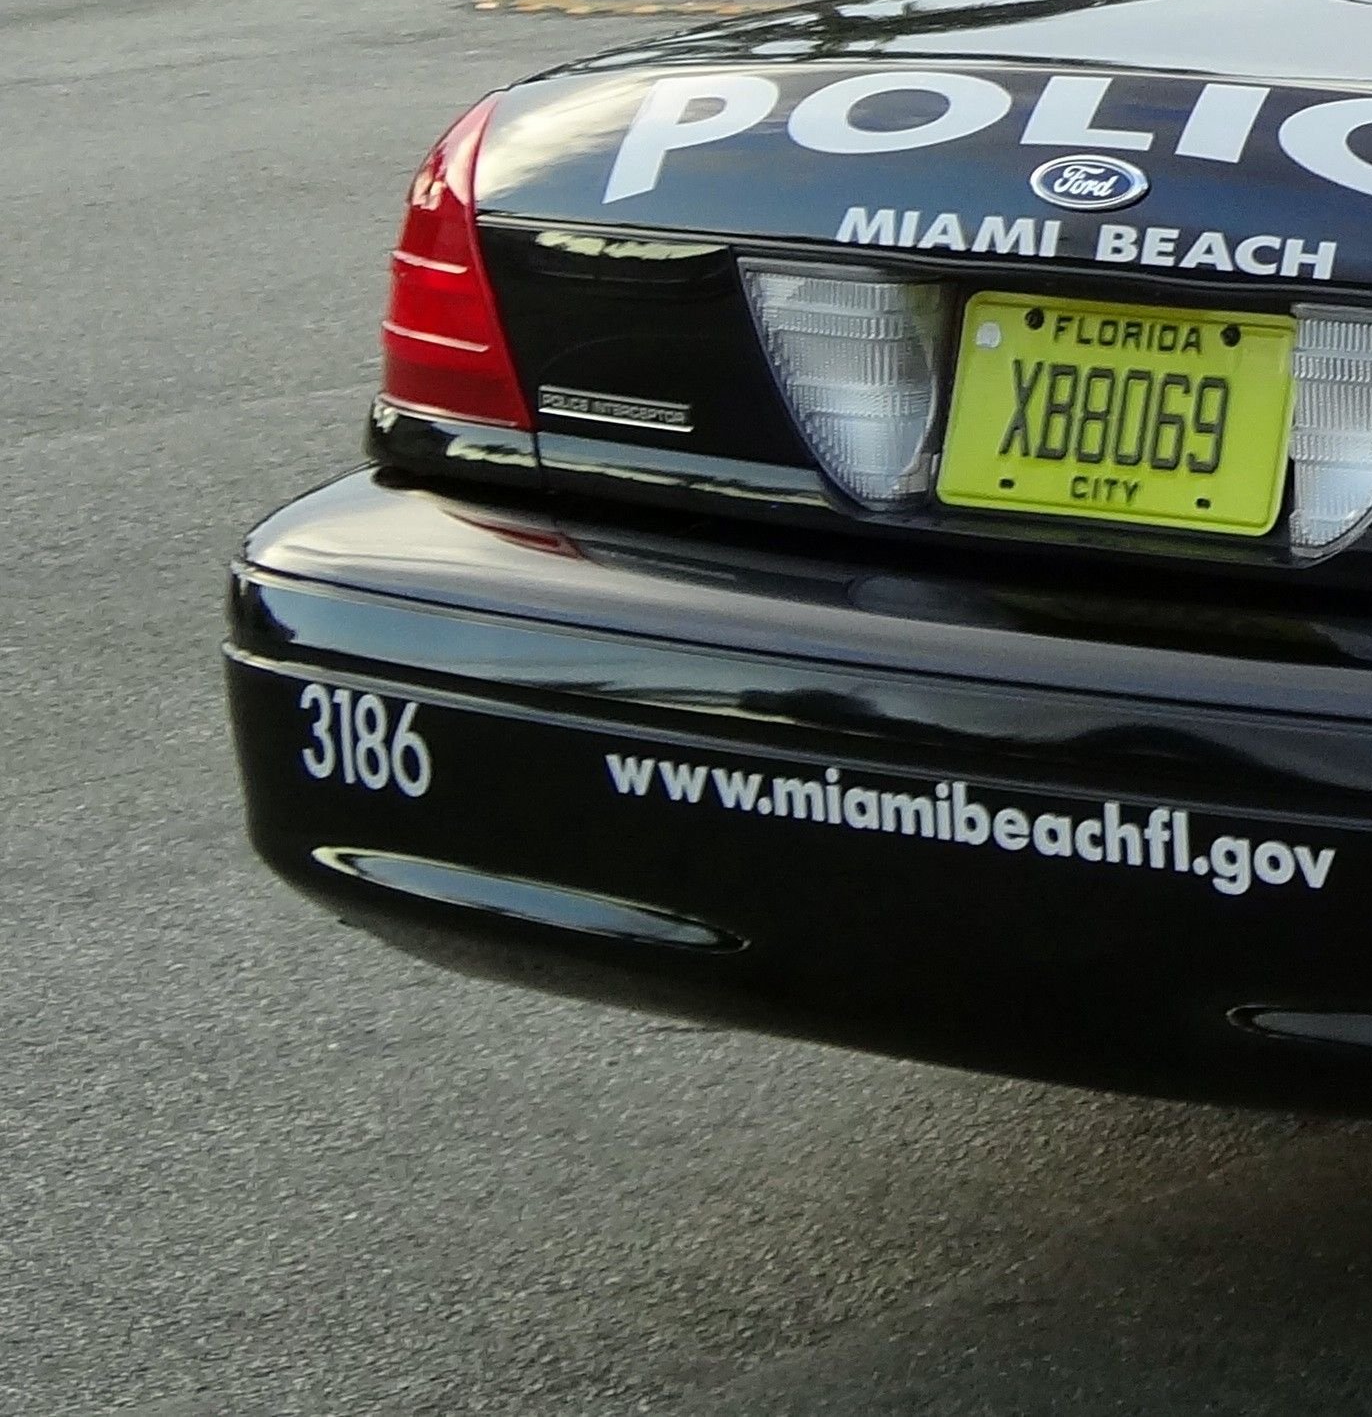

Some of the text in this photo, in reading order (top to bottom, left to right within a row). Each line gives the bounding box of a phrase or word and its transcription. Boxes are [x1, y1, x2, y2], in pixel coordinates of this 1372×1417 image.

[1053, 165, 1119, 197] Ford
[836, 207, 1338, 280] MIAMI BEACH
[1053, 315, 1203, 354] FLORIDA
[542, 394, 588, 412] POLICE
[998, 358, 1230, 475] XB8069
[1070, 475, 1140, 504] CITY
[300, 683, 432, 797] 3186
[605, 752, 1336, 896] www.miamibeachfl.gov
